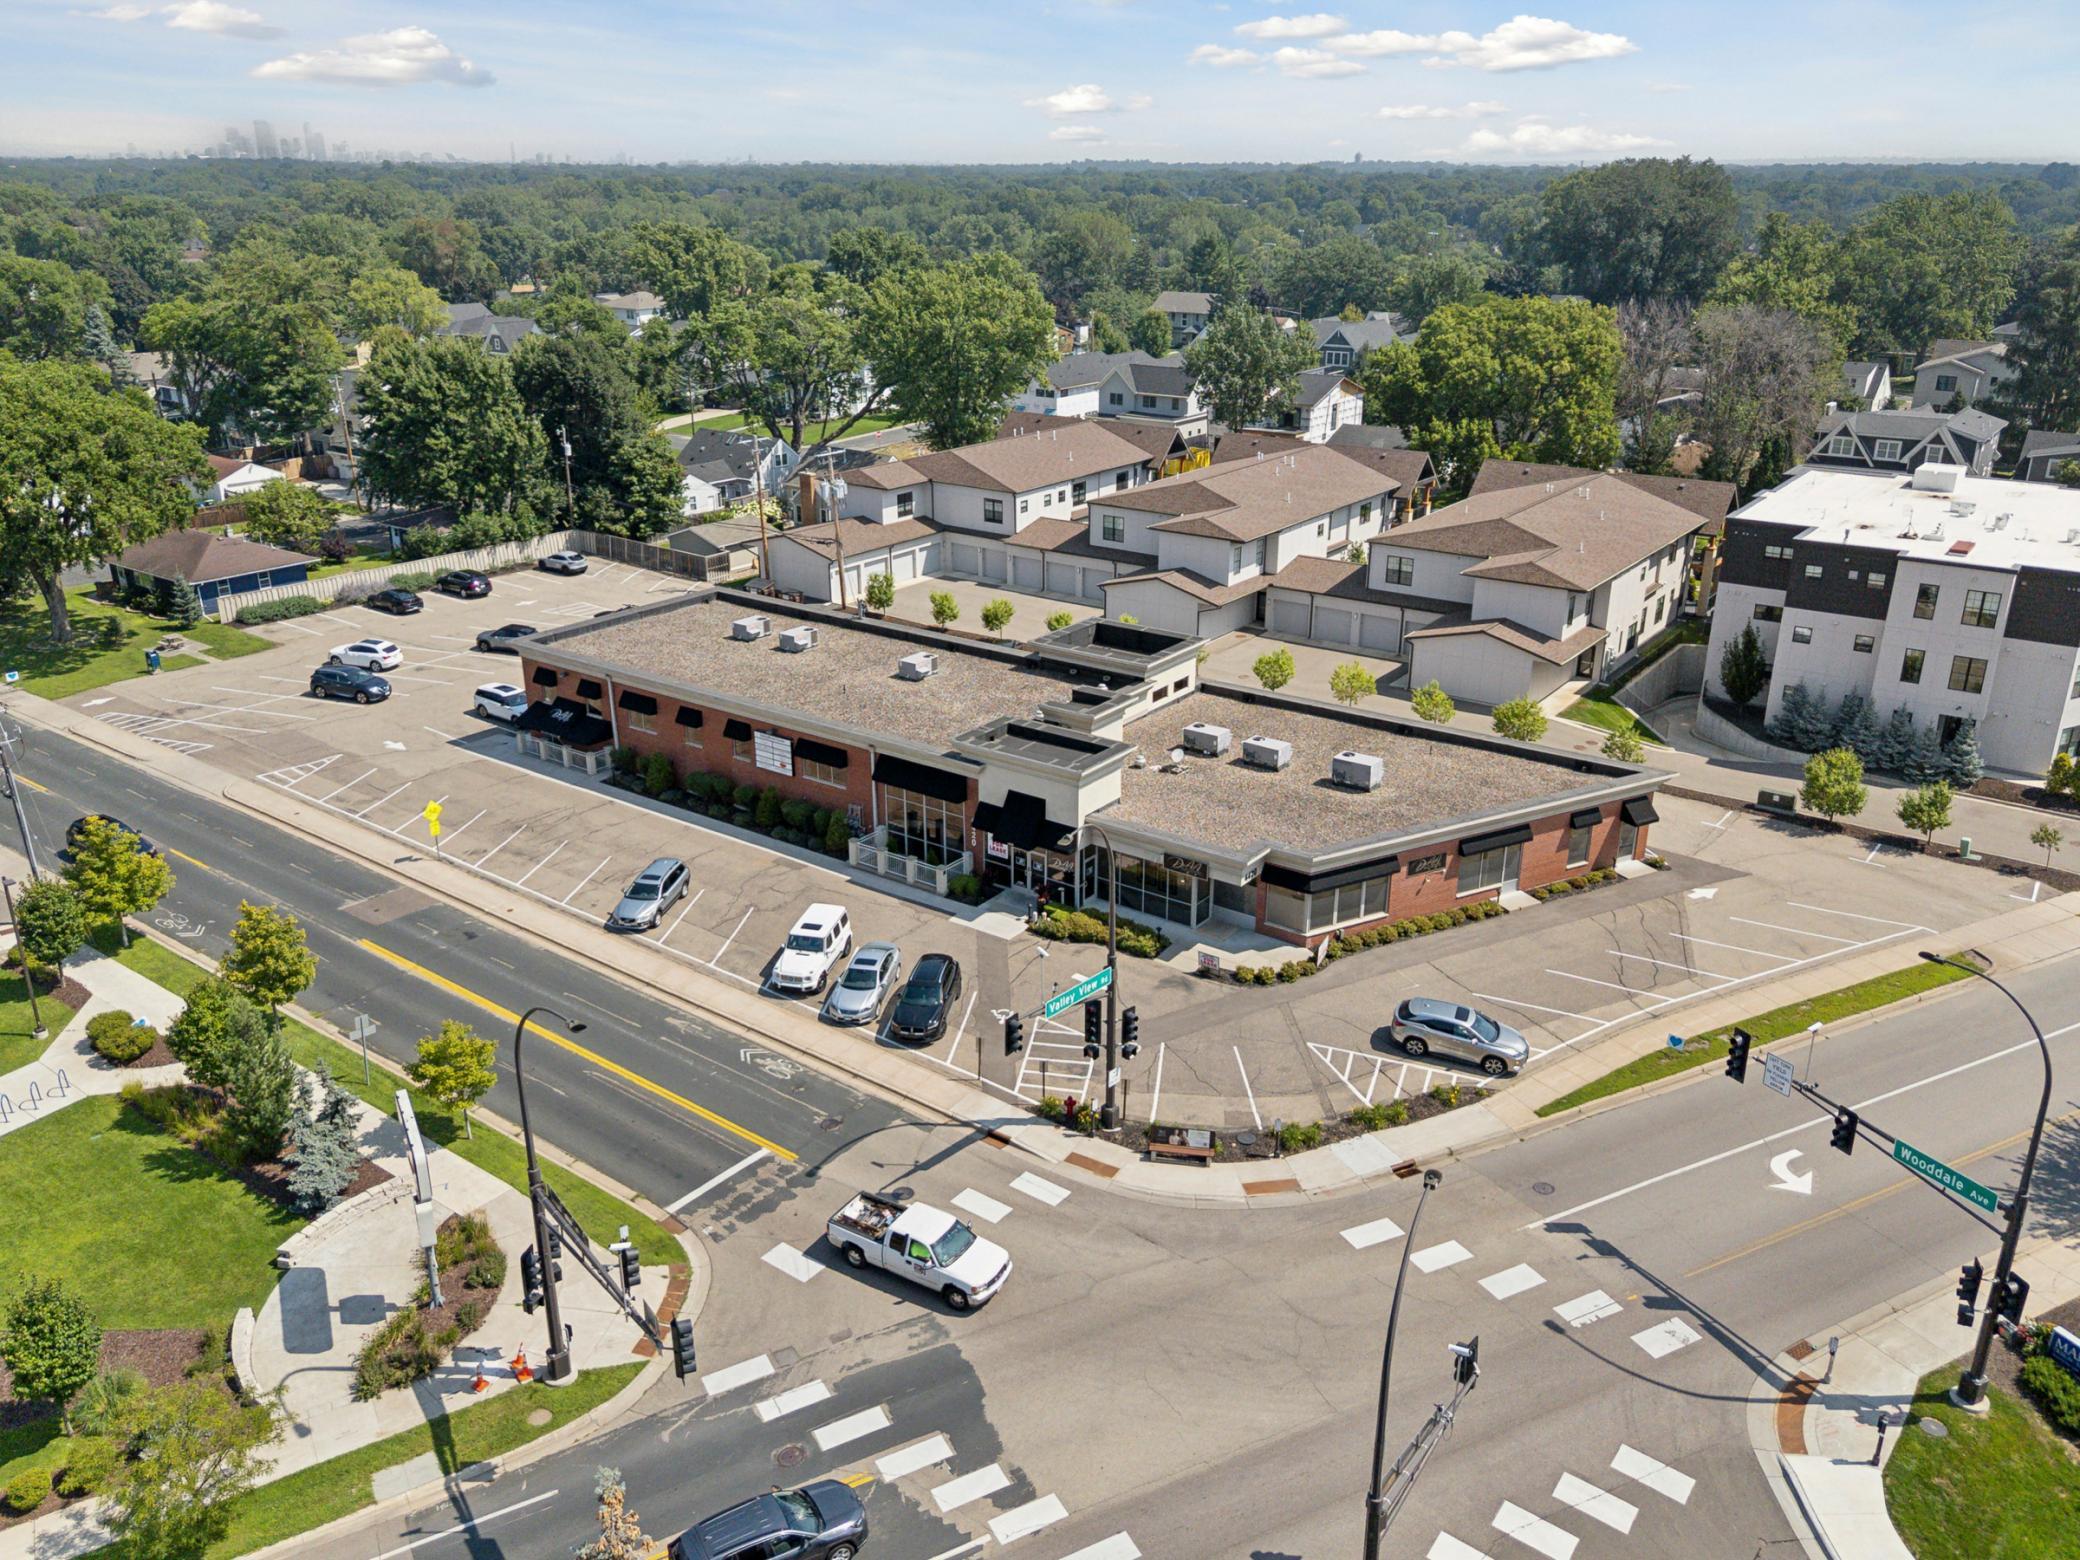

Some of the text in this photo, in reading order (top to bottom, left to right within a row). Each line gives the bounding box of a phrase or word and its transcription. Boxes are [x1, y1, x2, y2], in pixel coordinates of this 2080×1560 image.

[1049, 993, 1075, 1013] Valley
[1078, 980, 1098, 996] View
[1901, 1146, 1989, 1206] Wooddale Ave
